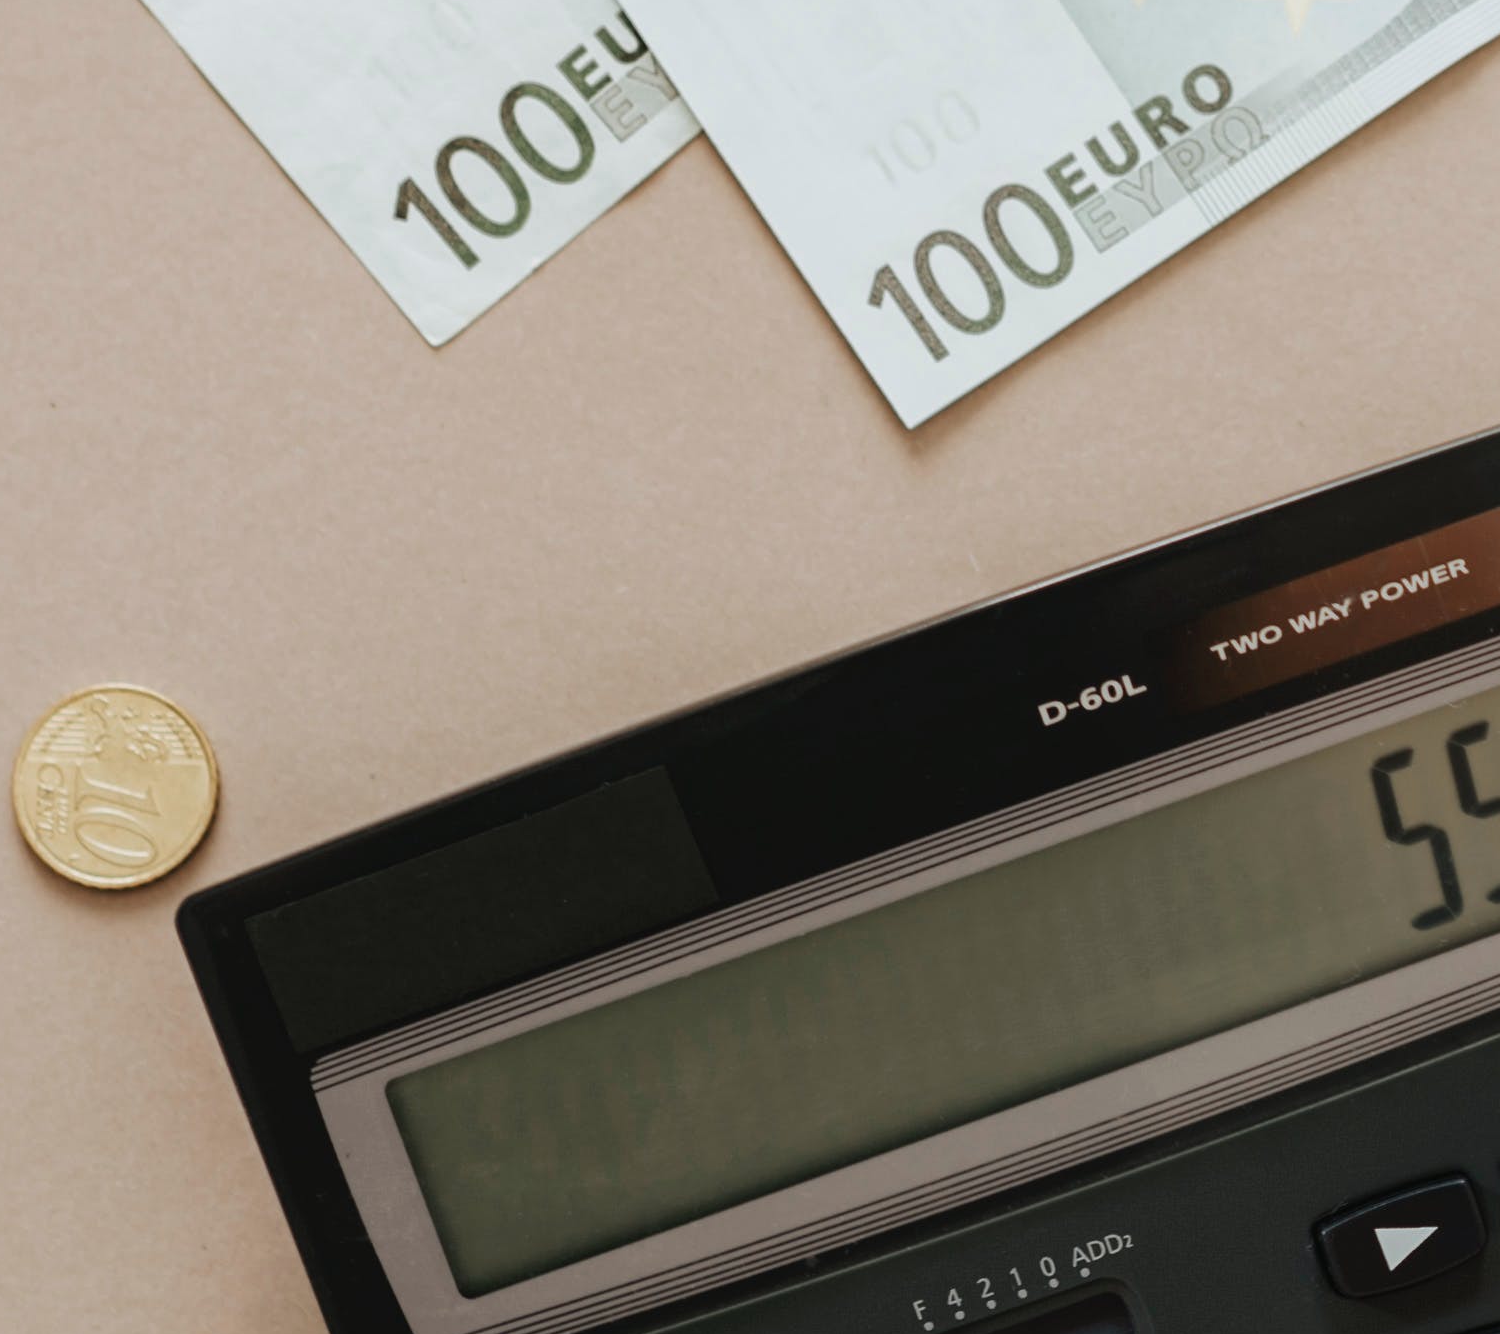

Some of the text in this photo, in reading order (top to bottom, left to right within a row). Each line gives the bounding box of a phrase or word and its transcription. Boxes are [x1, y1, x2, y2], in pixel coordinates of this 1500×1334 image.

[392, 79, 595, 271] 100
[866, 62, 1234, 363] 100 EURO
[1209, 558, 1470, 661] TWO WAY POWER
[1037, 674, 1148, 726] D-60L
[912, 1299, 927, 1321] F
[947, 1288, 963, 1307] 4
[976, 1277, 995, 1299] 2
[1009, 1267, 1022, 1286] 1
[1039, 1256, 1056, 1277] 0
